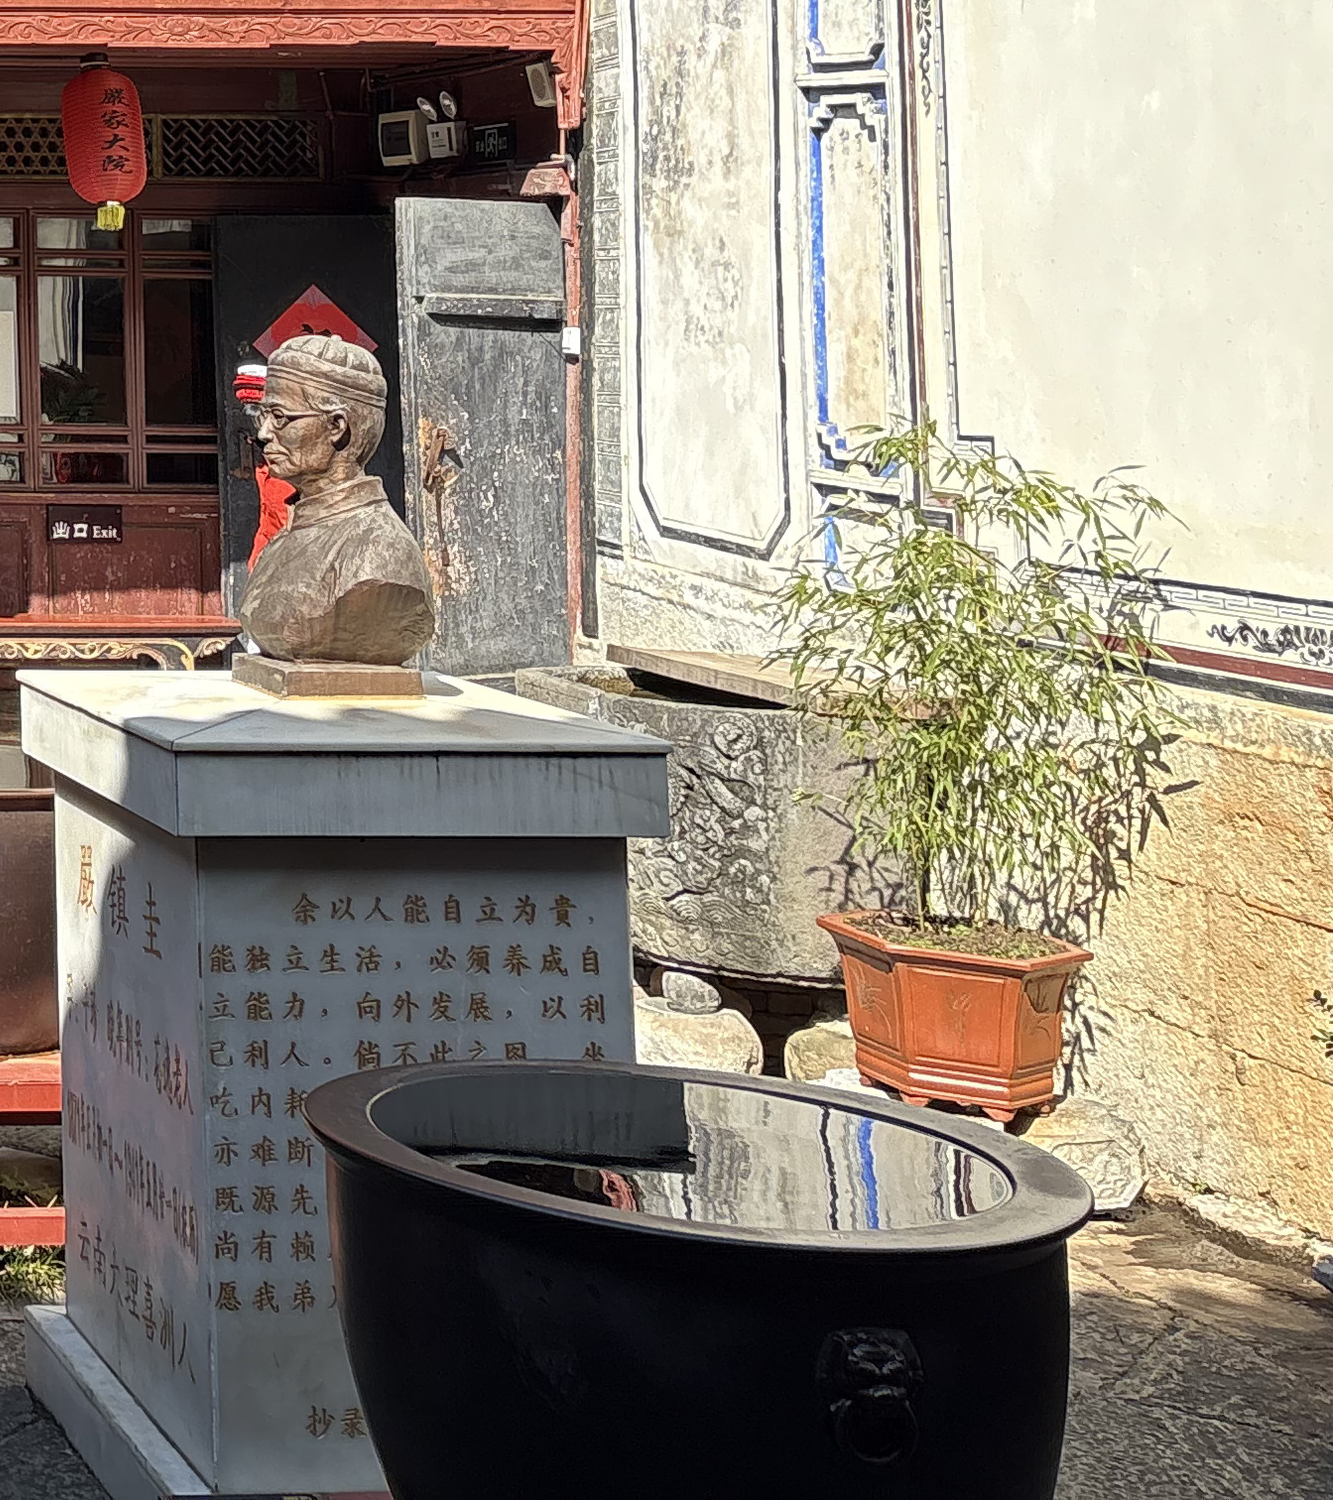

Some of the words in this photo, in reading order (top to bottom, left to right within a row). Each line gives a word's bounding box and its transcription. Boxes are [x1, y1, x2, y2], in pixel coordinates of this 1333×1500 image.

[93, 525, 117, 539] Exit
[213, 1136, 315, 1168] 亦难断
[214, 1185, 319, 1217] 既源先
[214, 1230, 332, 1263] 尚有赖
[214, 1282, 338, 1314] 愿我弟
